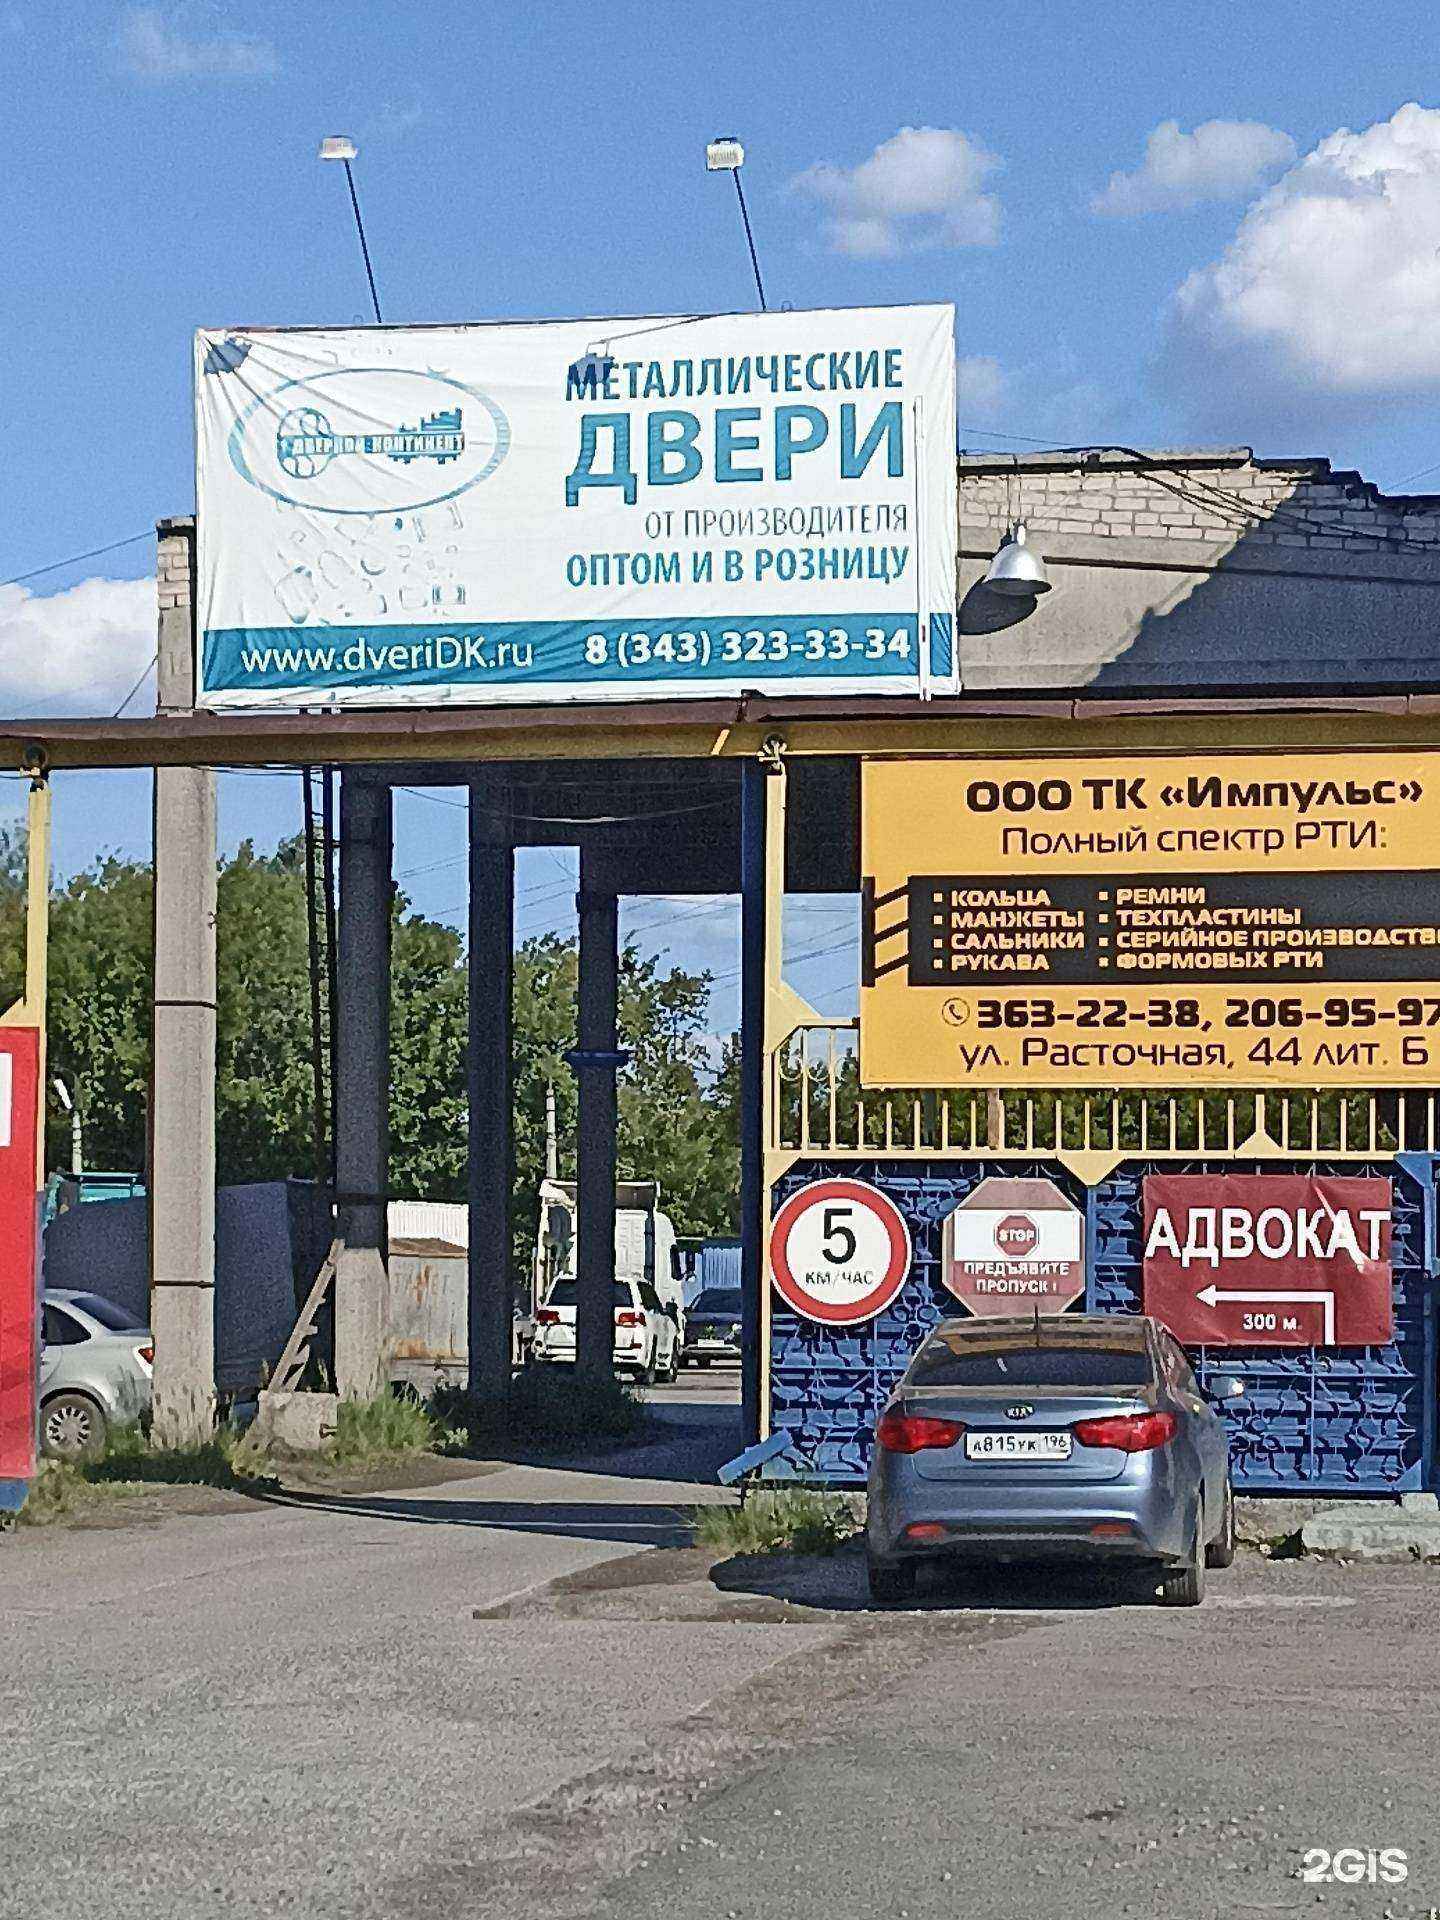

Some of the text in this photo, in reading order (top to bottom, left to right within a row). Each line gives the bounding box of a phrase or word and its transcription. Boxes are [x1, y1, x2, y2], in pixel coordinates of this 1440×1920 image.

[565, 348, 903, 401] МЕТАЛЛИЧЕСКИЕ
[565, 401, 904, 507] ДВЕРИ
[645, 504, 908, 538] ОТ ПРОИЗВОДИТЕЛЯ
[566, 546, 910, 587] ОПТОМ И В РОЗНИЦУ
[240, 636, 533, 672] www.dveriDK.ru
[584, 629, 912, 668] 8 (343) 323-33-34
[966, 775, 1424, 814] ООО ТК «Импульс»
[1002, 820, 1387, 857] Полный спектр РТИ:
[951, 889, 1050, 907] КОЛЬЦА
[1116, 887, 1206, 905] РЕМНИ
[951, 911, 1084, 928] МАНЖЕТЫ
[1116, 908, 1301, 926] ТЕХПЛАСТИНЫ
[951, 931, 1085, 950] САЛЬНИКИ
[1116, 927, 1440, 947] СЕРИЙНОЕ ПРОИЗВОДСТВ
[951, 953, 1050, 971] РУКАВА
[1116, 950, 1324, 969] ФОРМОВЫХ РТИ
[977, 998, 1440, 1032] 363-22-38, 206-95-97
[958, 1043, 1010, 1073] ул.
[1022, 1037, 1234, 1069] Расточная,
[1248, 1036, 1303, 1066] 44
[1313, 1042, 1388, 1066] лит.
[822, 1208, 857, 1265] 5
[998, 1228, 1035, 1242] STOP
[1145, 1208, 1392, 1268] АДВОКАТ
[805, 1270, 874, 1288] КМ/ЧАС
[964, 1262, 1070, 1277] ПРЕДЪЯВИТЕ
[976, 1278, 1048, 1294] ПРОПУСК
[1242, 1313, 1276, 1331] 300
